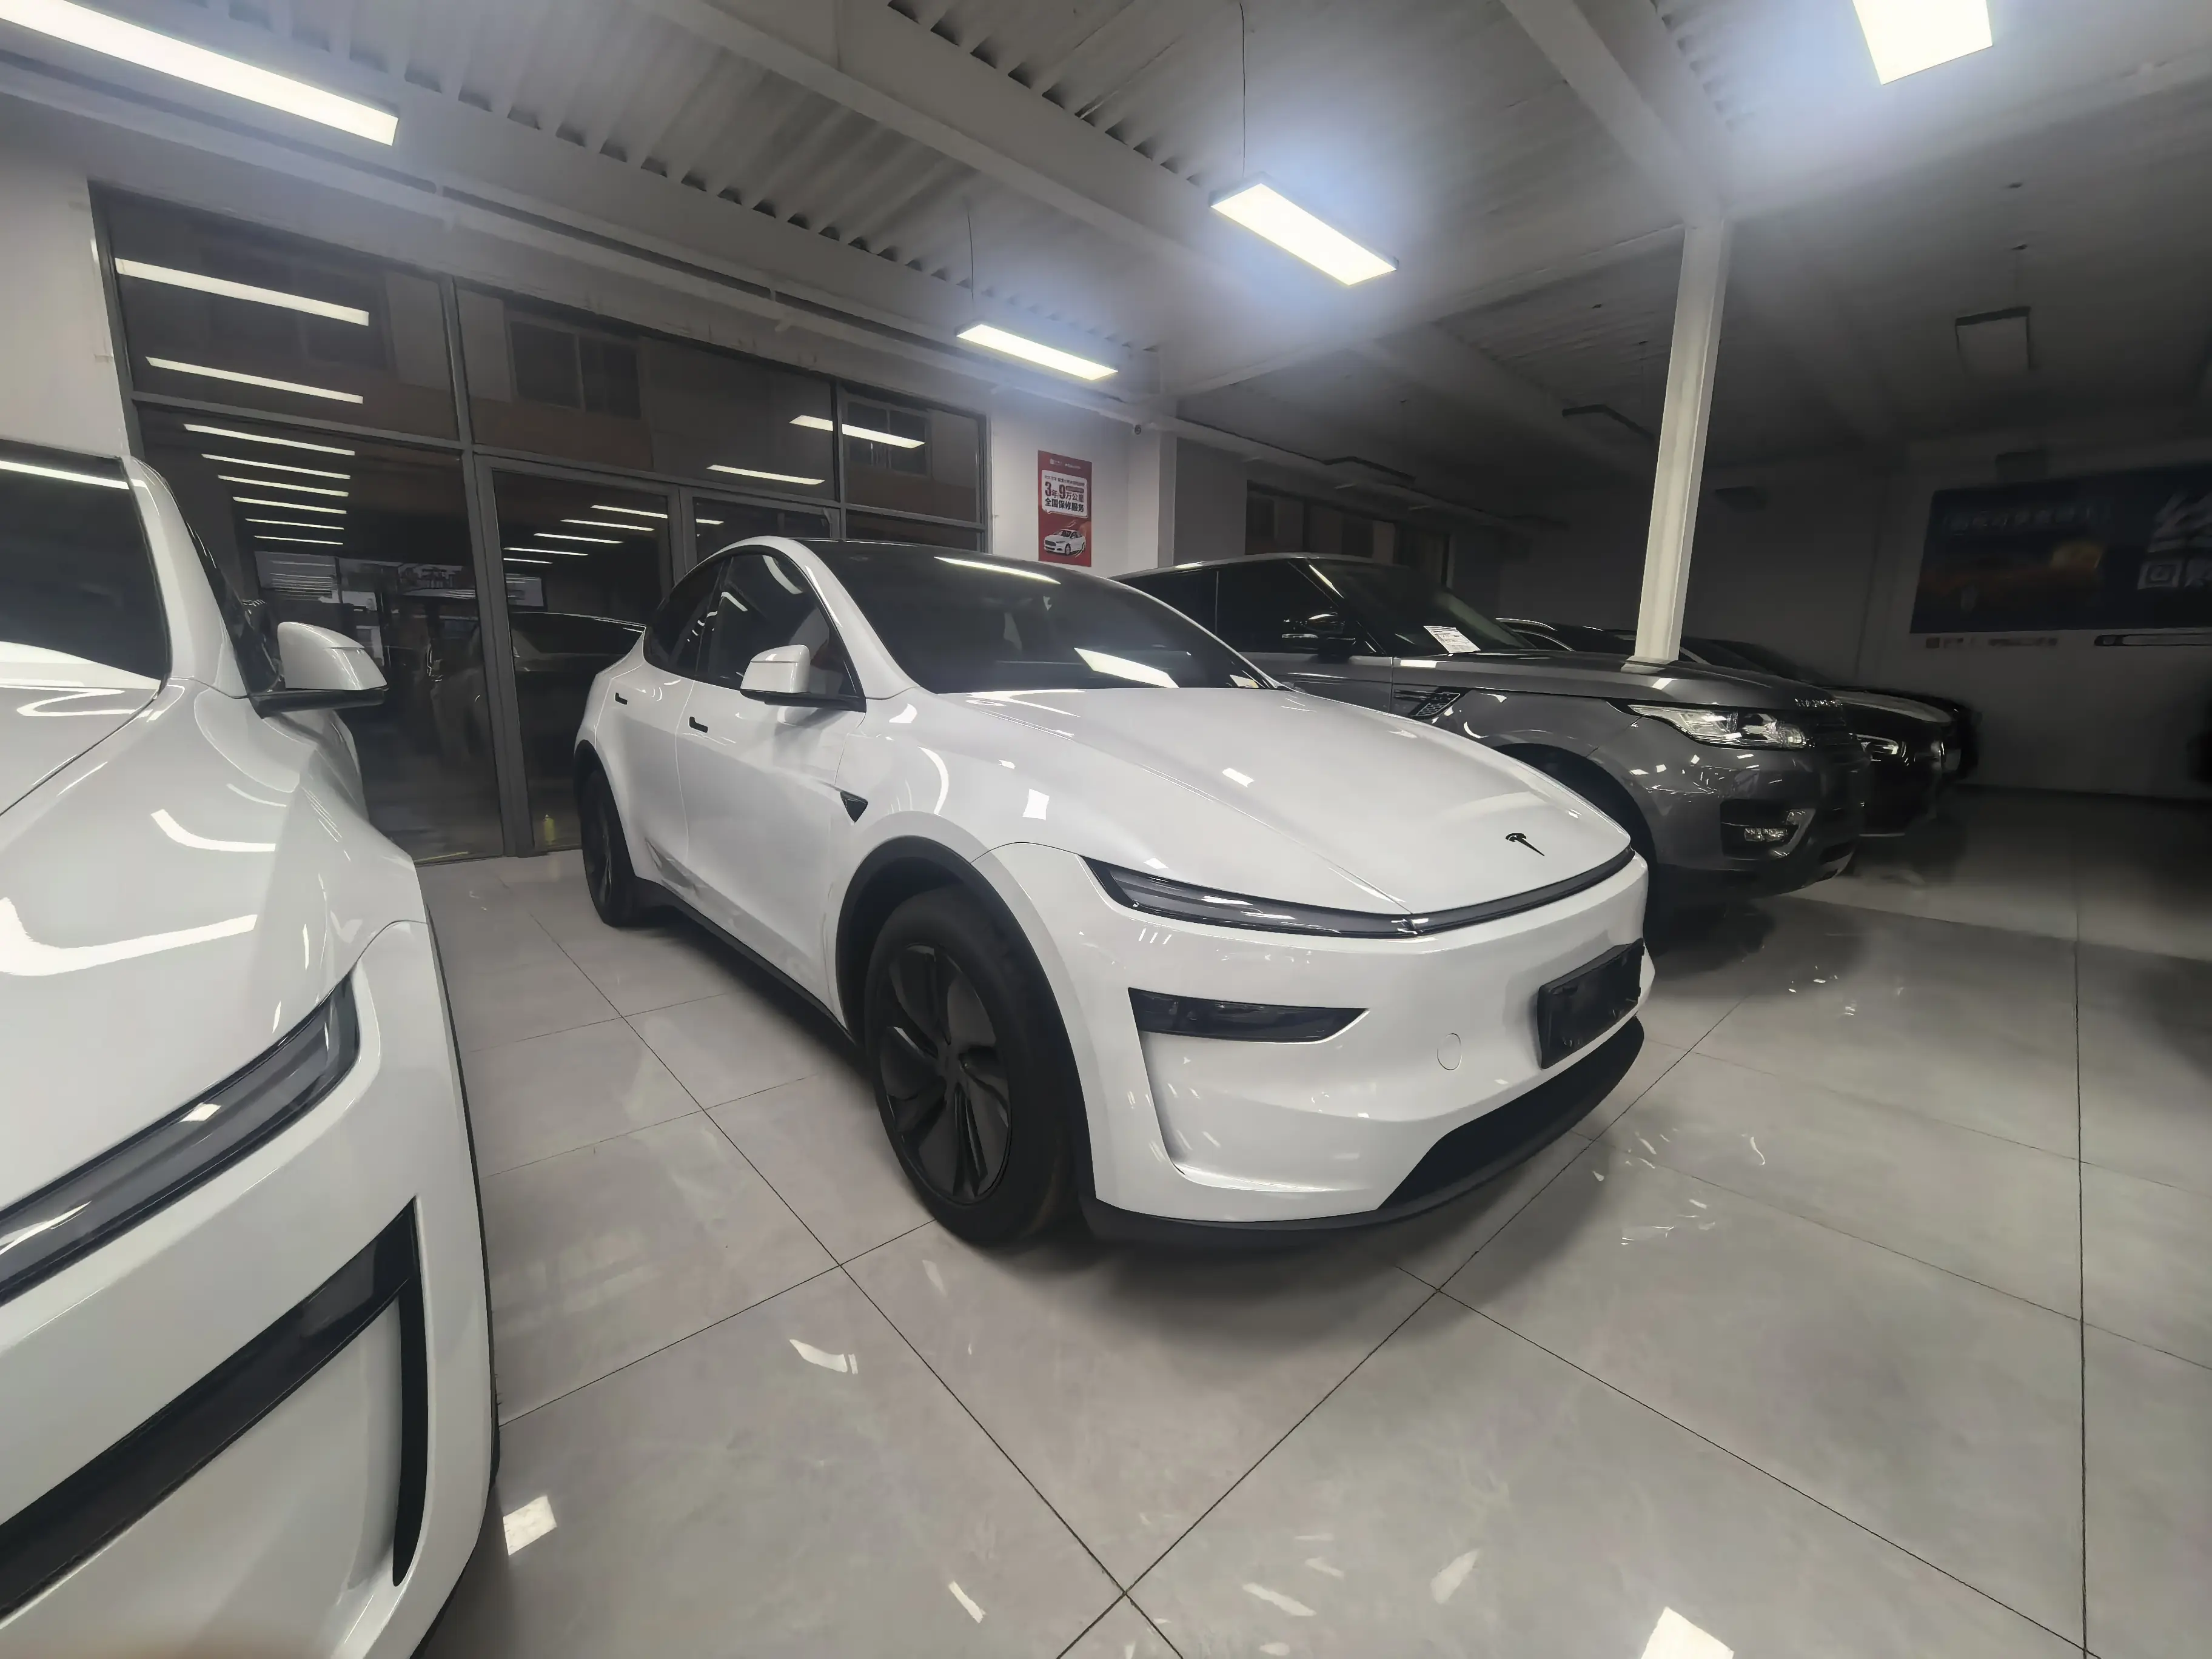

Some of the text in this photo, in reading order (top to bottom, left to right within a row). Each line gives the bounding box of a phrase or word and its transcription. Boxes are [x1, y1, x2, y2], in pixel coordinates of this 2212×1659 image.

[1045, 498, 1084, 512] 全国保修服务
